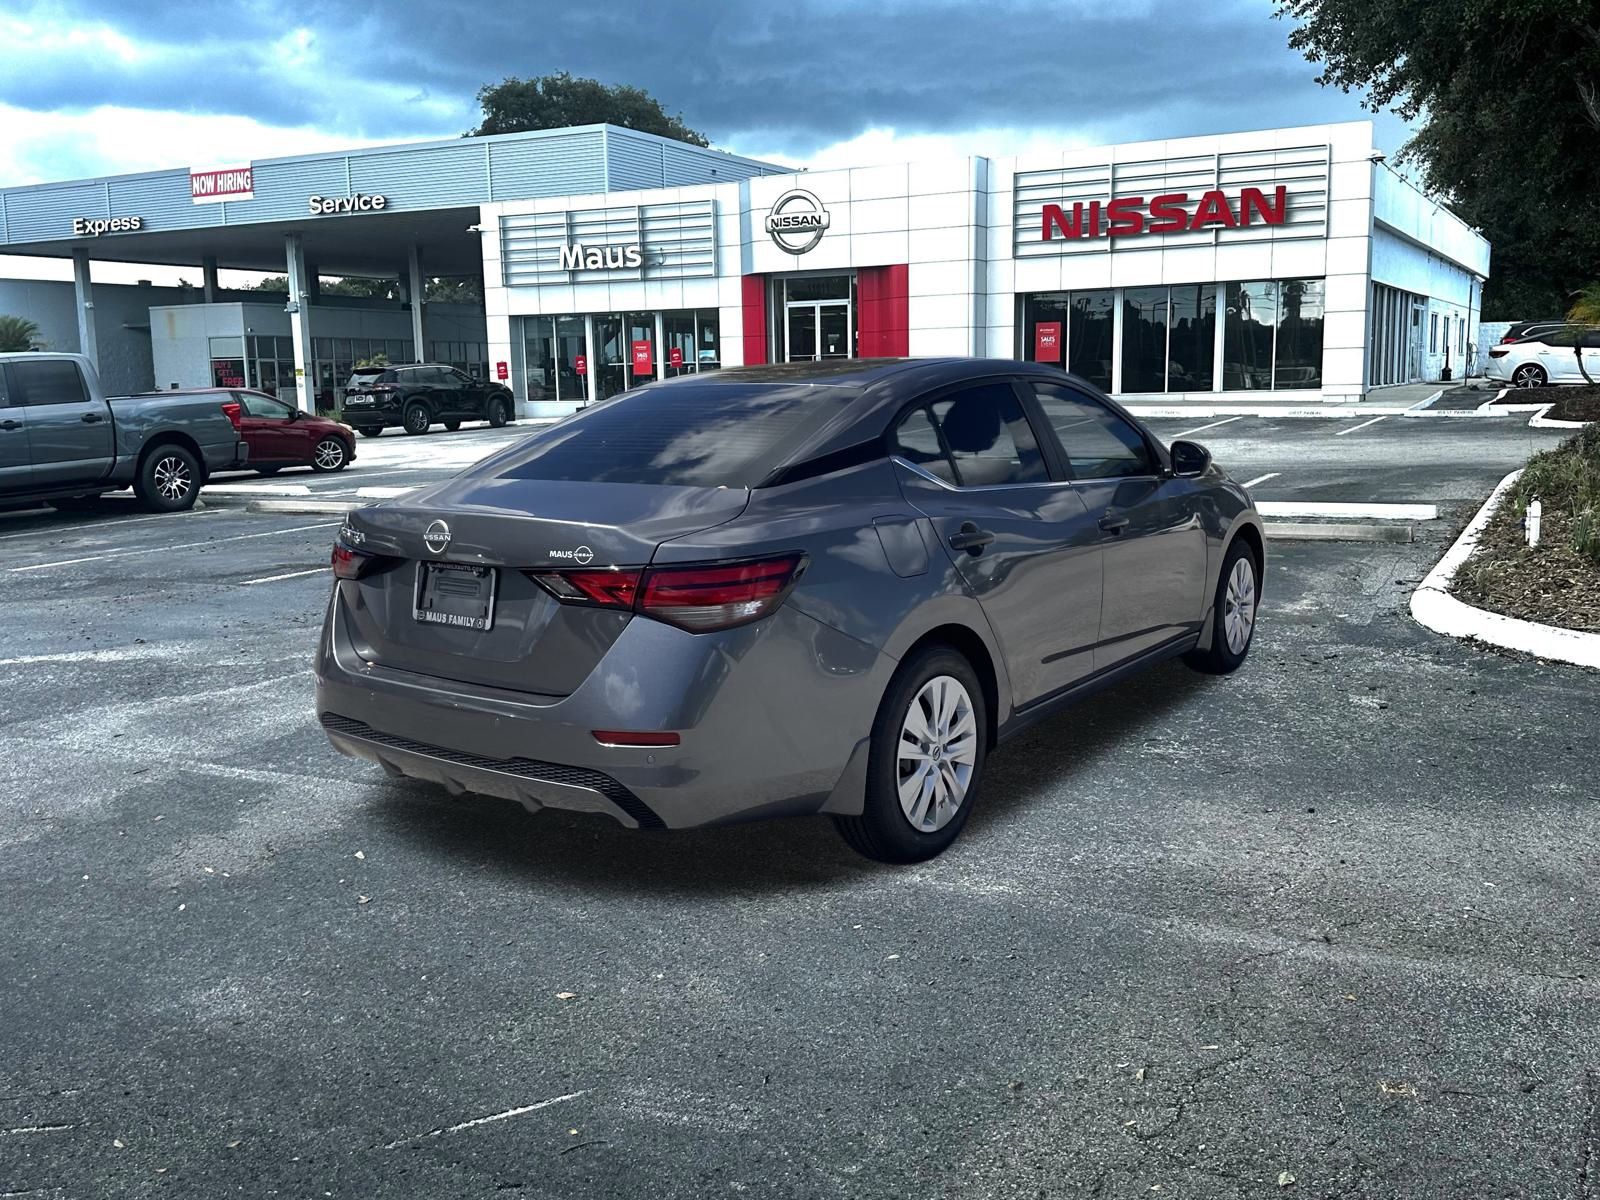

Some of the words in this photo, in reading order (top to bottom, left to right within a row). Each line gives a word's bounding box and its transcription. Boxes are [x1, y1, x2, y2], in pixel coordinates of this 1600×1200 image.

[192, 174, 215, 195] NOW
[217, 171, 251, 192] HIRING
[309, 193, 386, 215] Service
[1042, 185, 1287, 241] NISSAN
[72, 215, 142, 236] Express
[770, 214, 822, 230] NISSAN
[559, 243, 643, 271] Maus
[222, 377, 244, 387] FREE
[423, 533, 451, 541] NISSAN
[549, 550, 573, 558] MAUS
[426, 611, 447, 624] MAUS
[448, 614, 476, 627] FAMILY
